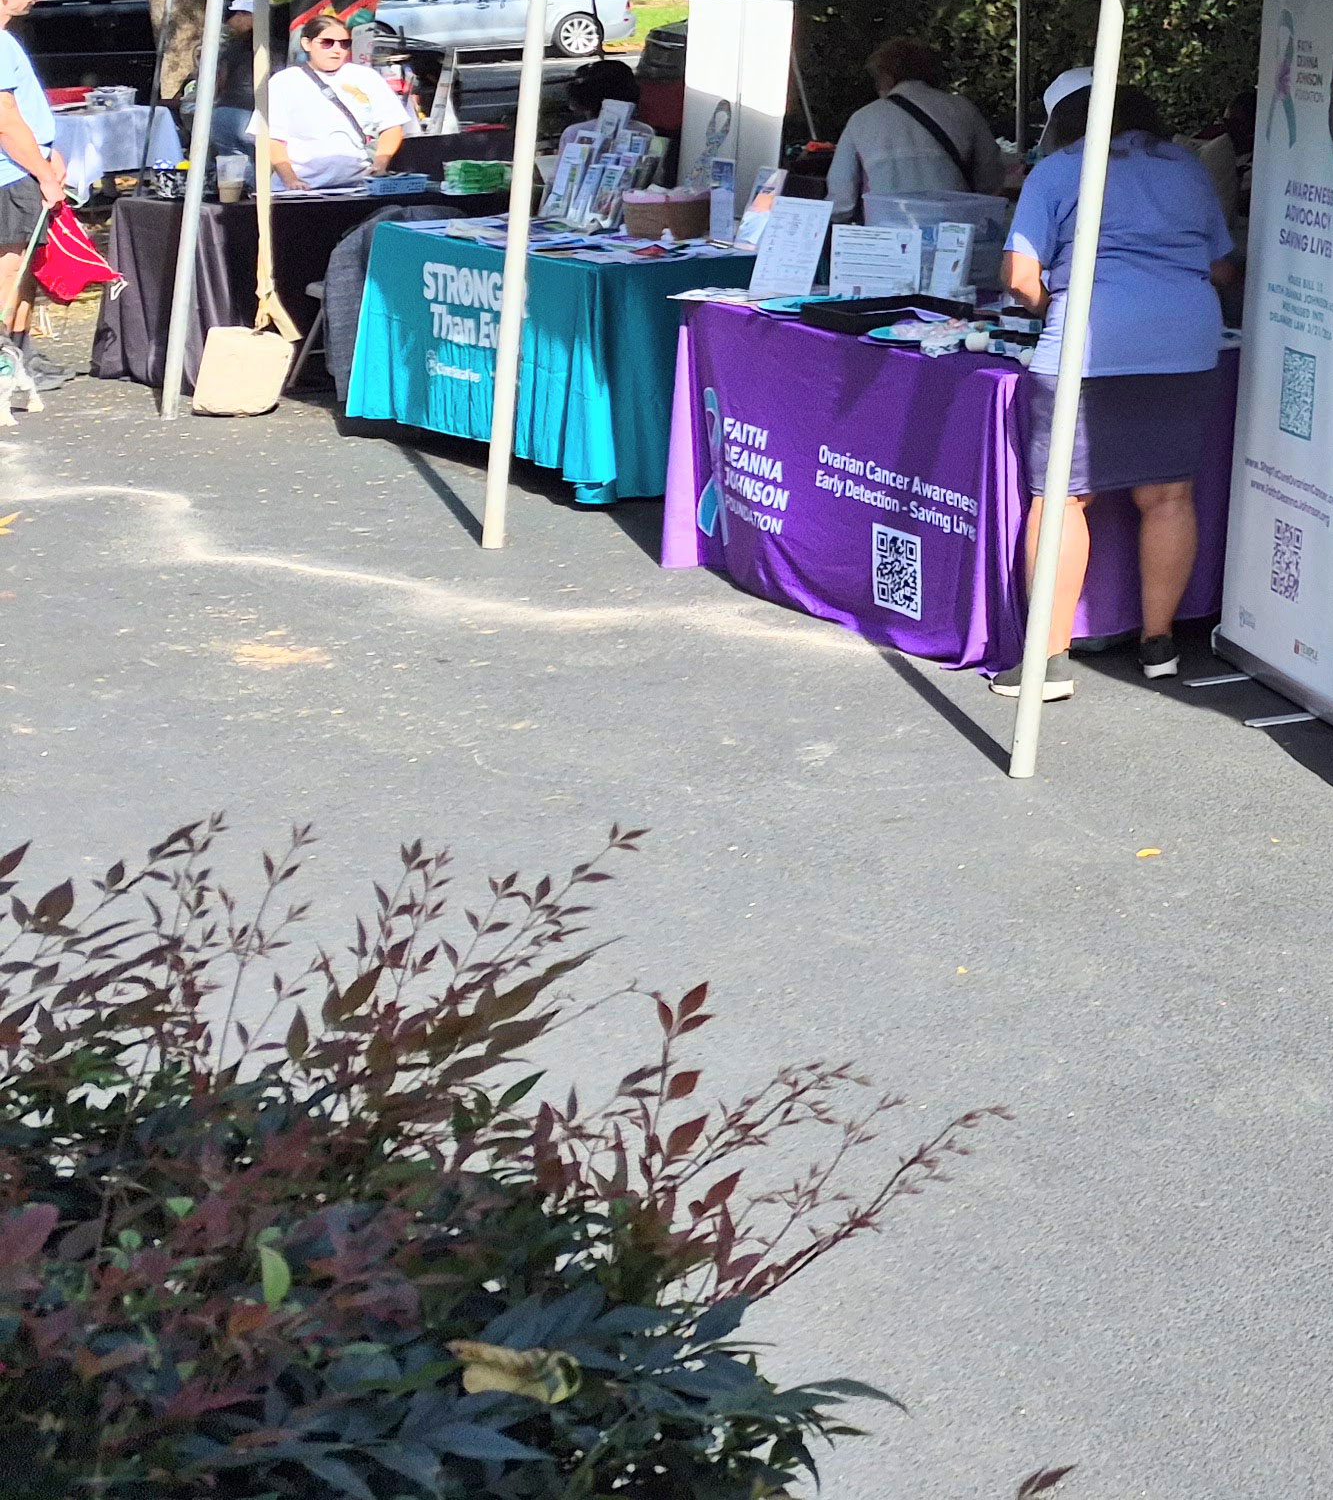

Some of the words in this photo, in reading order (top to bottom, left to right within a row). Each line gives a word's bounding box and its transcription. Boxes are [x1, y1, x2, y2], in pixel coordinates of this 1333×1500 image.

[1284, 205, 1331, 231] ADVOCACY
[1279, 229, 1308, 252] SAVING
[1309, 236, 1332, 259] LIVES
[423, 261, 520, 316] STRONG
[430, 303, 477, 345] Than
[478, 311, 501, 349] Ev
[723, 417, 768, 450] FAITH
[723, 466, 790, 511] JOHNSON
[818, 445, 864, 477] Ovarian
[865, 461, 911, 491] Cancer
[815, 470, 845, 498] Early
[846, 480, 899, 513] Detection
[909, 501, 951, 534] Saving
[953, 515, 977, 542] Live
